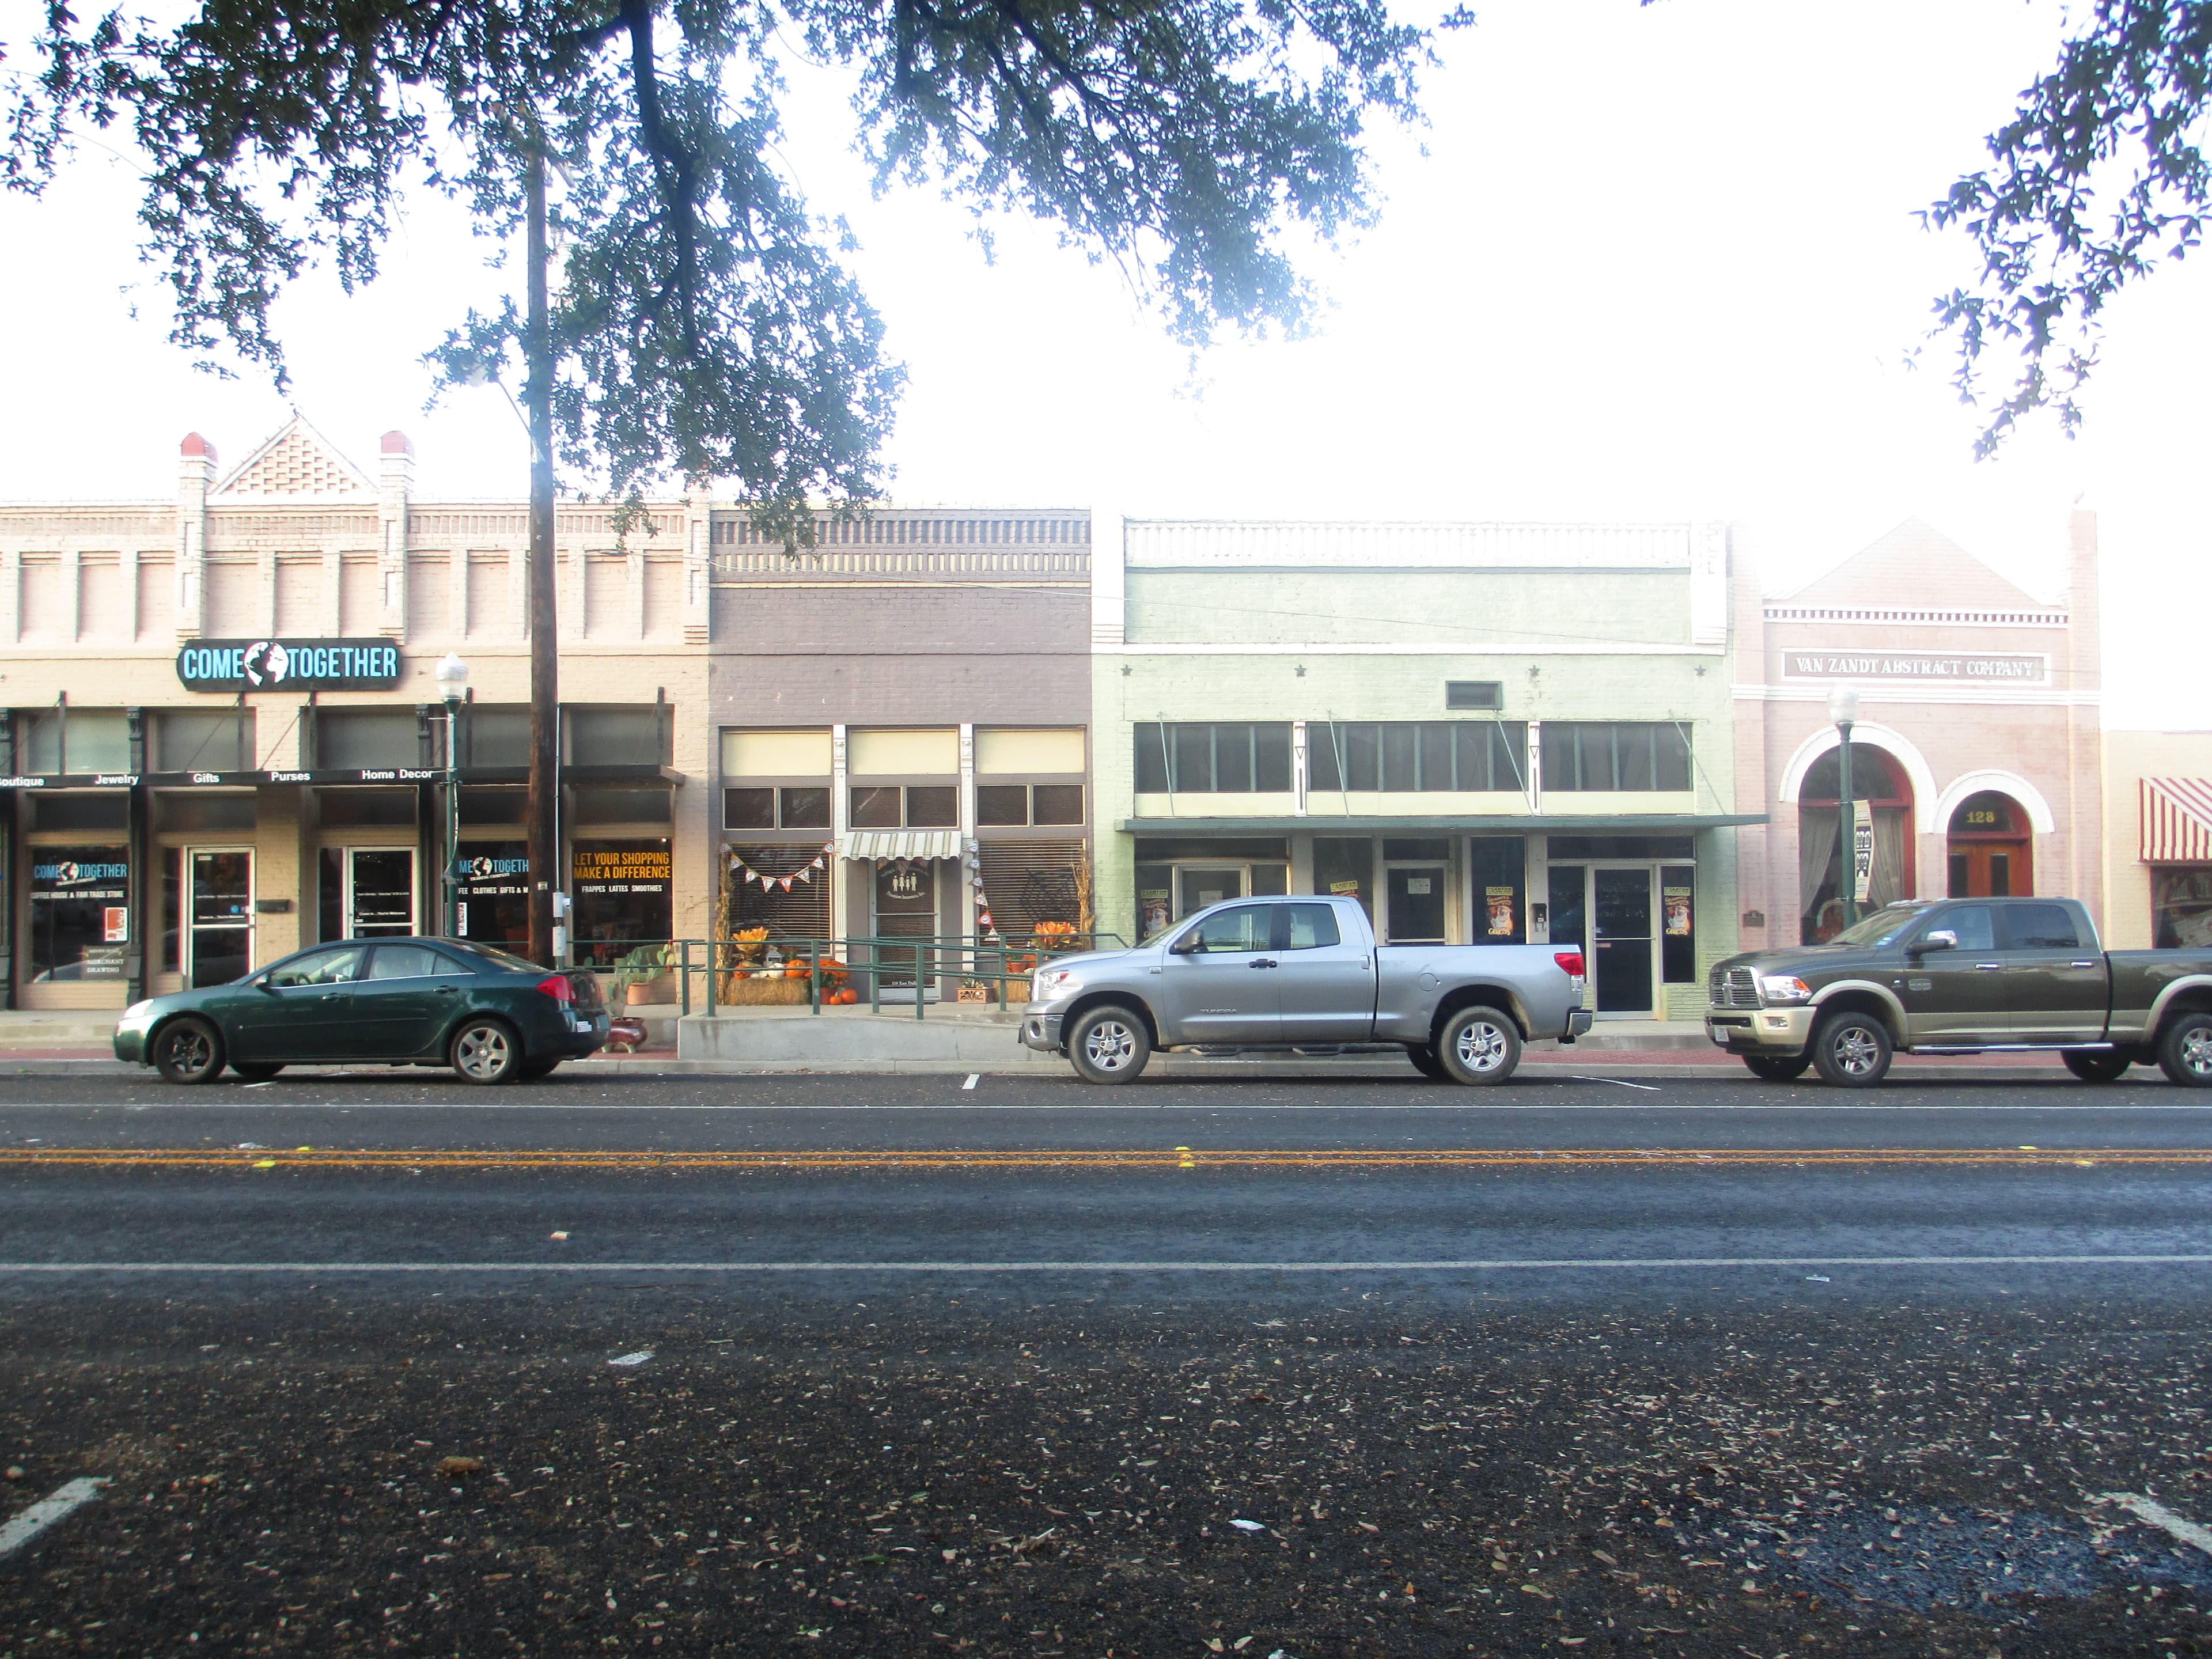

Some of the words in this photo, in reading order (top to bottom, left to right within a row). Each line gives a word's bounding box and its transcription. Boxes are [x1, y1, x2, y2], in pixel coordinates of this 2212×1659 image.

[184, 649, 245, 679] COME
[287, 647, 397, 677] TOGETHER
[1796, 657, 1824, 673] VAN
[1827, 657, 1879, 674] ZANDT
[1881, 658, 1961, 676] ABSTRACT
[1965, 661, 2033, 677] COMPANY
[95, 774, 139, 786] Jewelry
[193, 773, 221, 783] Gifts
[271, 772, 311, 781] Purses
[362, 770, 395, 779] Home
[399, 769, 433, 778] Decor
[0, 778, 44, 787] outique
[1967, 810, 1994, 823] 128
[575, 853, 592, 865] LET
[594, 853, 620, 865] YOUR
[622, 852, 669, 865] SHOPPING
[34, 865, 60, 878] COME
[79, 864, 127, 877] TOGETHER
[459, 860, 473, 873] ME
[493, 859, 529, 873] TOGETH
[574, 866, 602, 879] MAKE
[604, 866, 611, 878] A
[613, 866, 671, 878] DIFFERENCE
